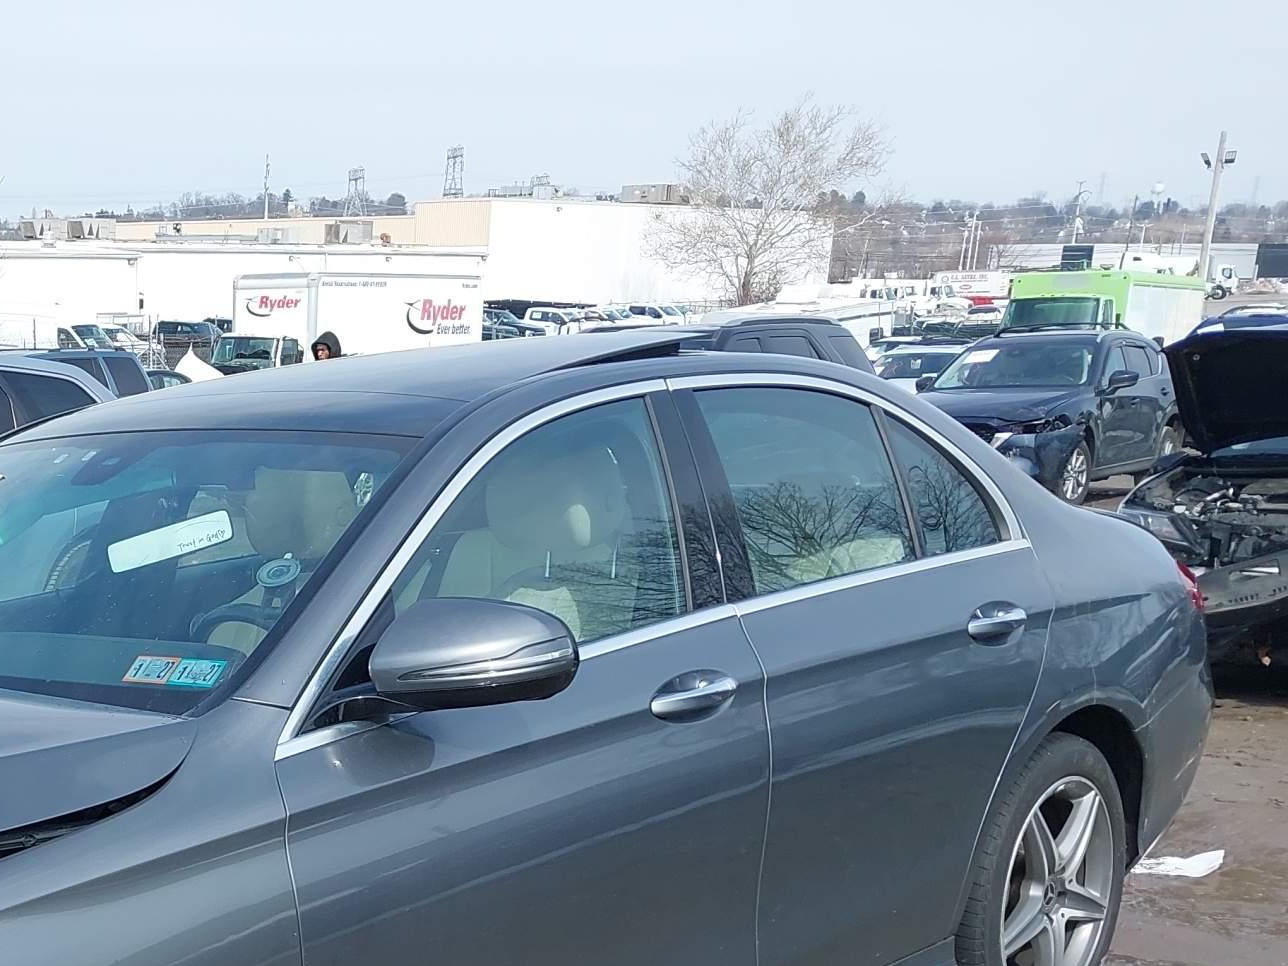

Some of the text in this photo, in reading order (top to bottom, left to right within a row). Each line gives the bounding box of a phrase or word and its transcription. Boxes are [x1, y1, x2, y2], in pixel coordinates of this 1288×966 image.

[259, 295, 301, 312] Ryder
[420, 299, 466, 326] Ryder
[437, 324, 450, 335] Ever
[157, 661, 176, 680] 27
[203, 664, 222, 683] 27
